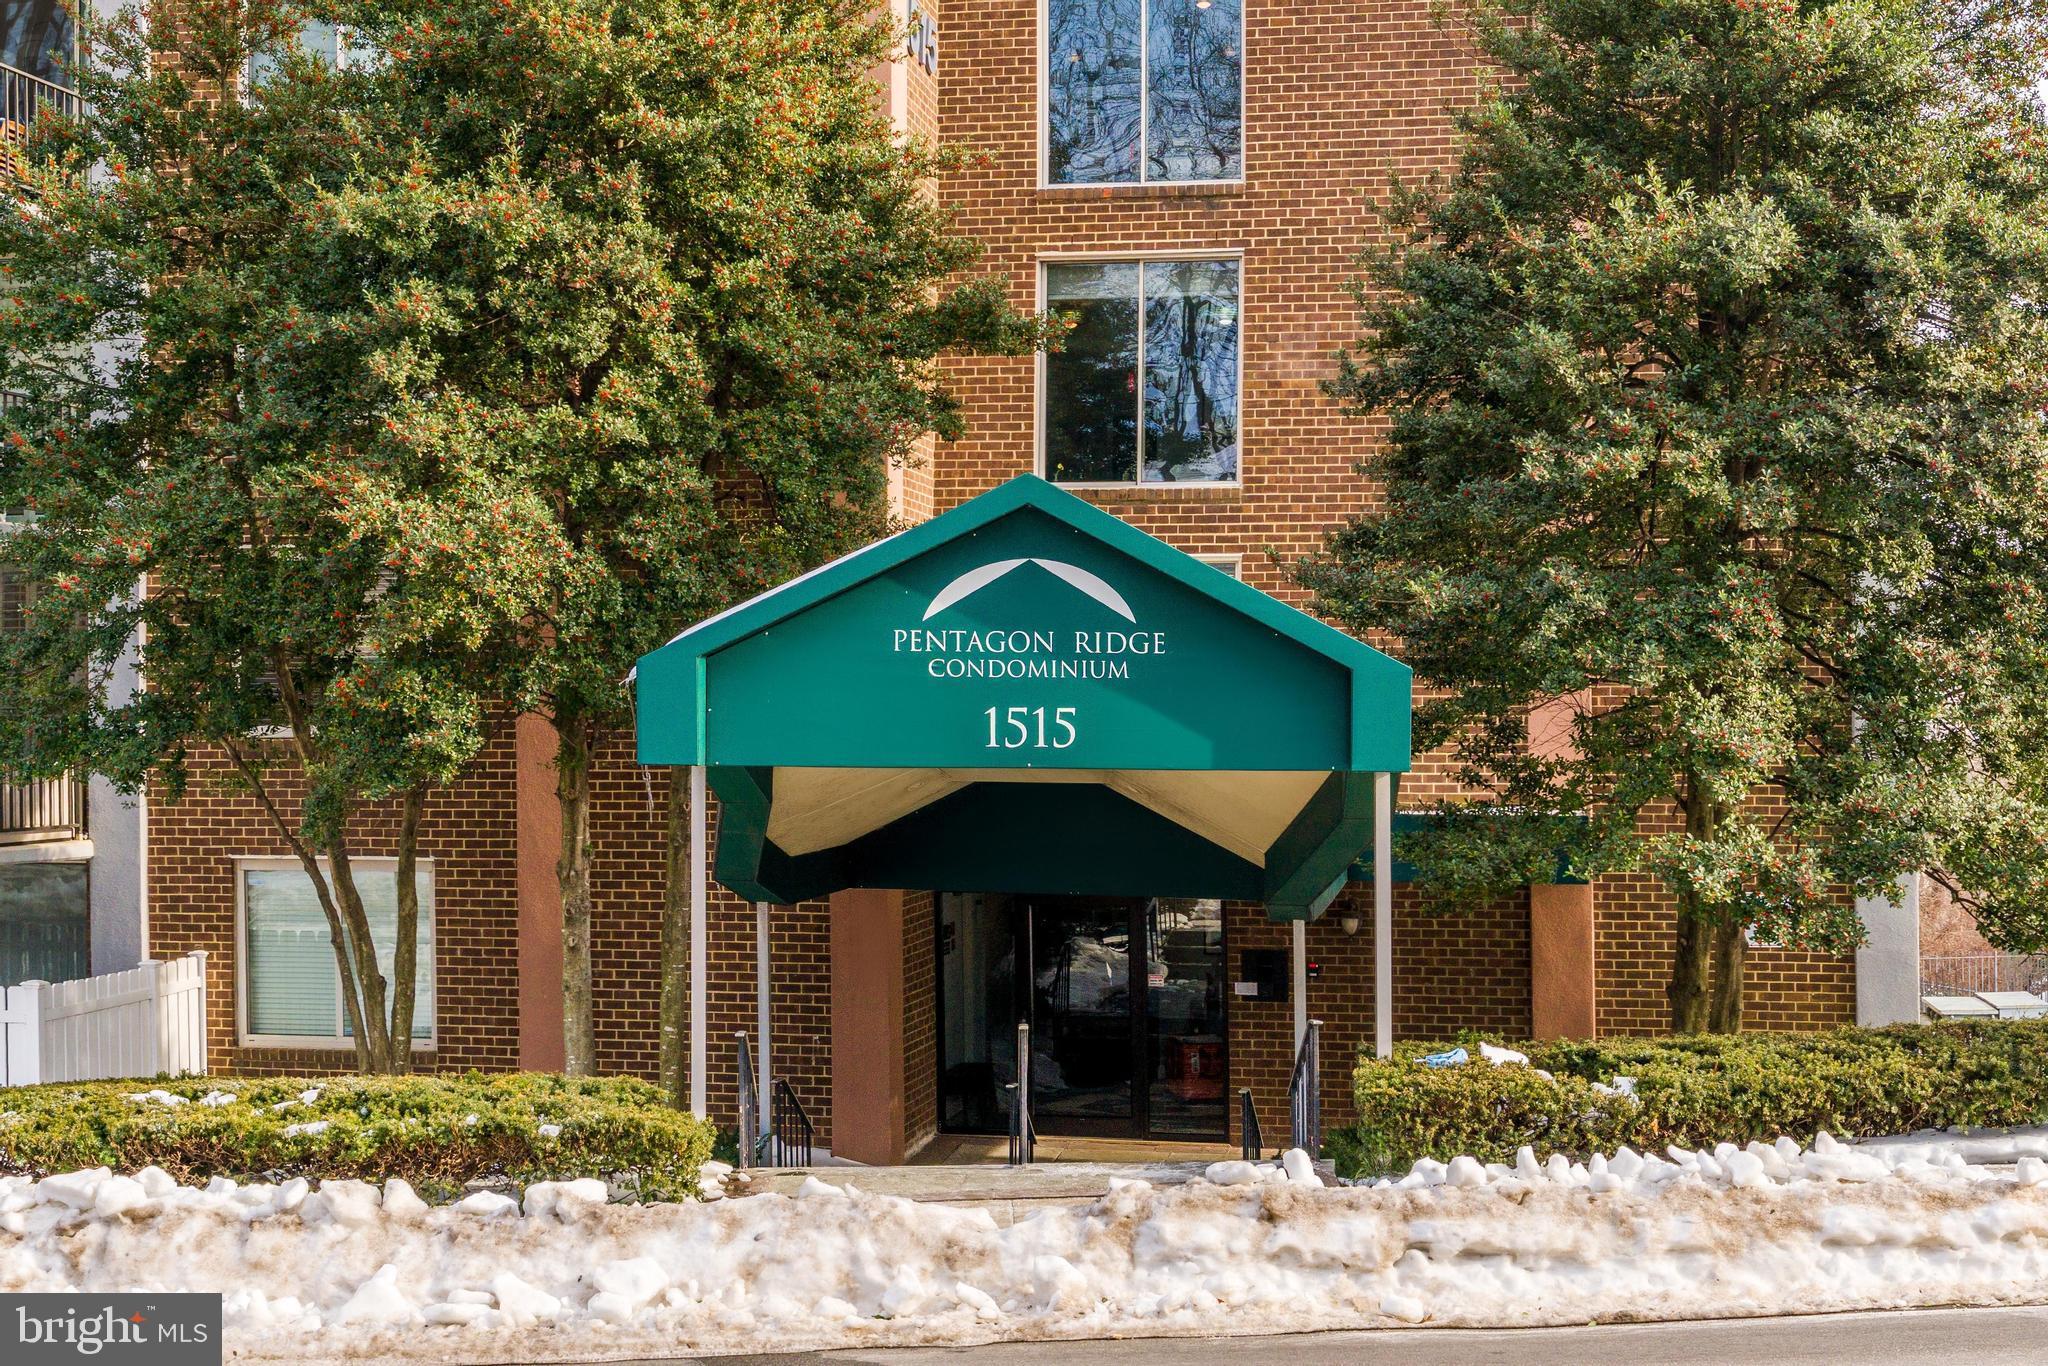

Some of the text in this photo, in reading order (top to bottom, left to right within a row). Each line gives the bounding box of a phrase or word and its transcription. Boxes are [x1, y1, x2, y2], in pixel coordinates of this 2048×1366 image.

[894, 630, 1166, 655] PENTAGON RIDGE
[928, 659, 1130, 679] CONDOMINIUM
[984, 706, 1077, 749] 1515
